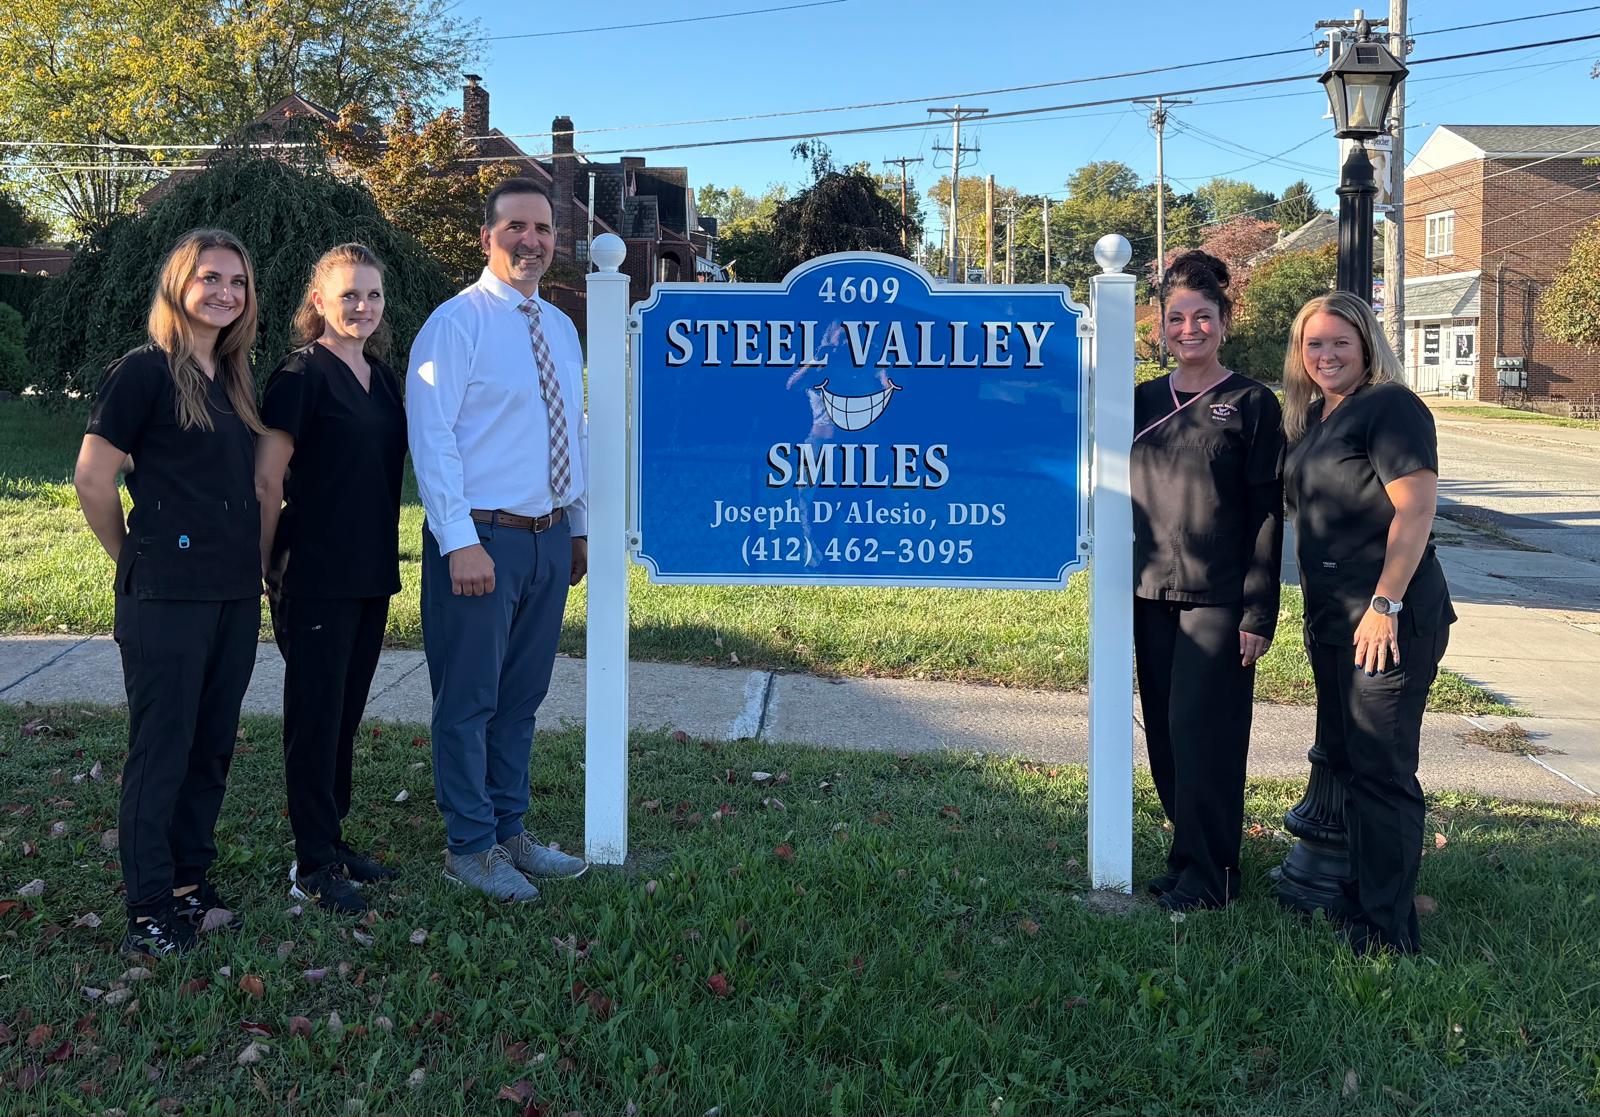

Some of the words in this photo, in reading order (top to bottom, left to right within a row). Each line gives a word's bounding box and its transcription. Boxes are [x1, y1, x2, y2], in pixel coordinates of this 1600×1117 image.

[818, 276, 900, 304] 4609
[666, 319, 829, 367] STEEL
[843, 321, 1055, 369] VALLEY
[766, 442, 950, 489] SMILES
[710, 500, 801, 530] Joseph
[813, 500, 937, 530] D'Alesio,
[948, 503, 1006, 526] DDS
[741, 536, 813, 566] (412)
[824, 537, 974, 564] 462-3095
